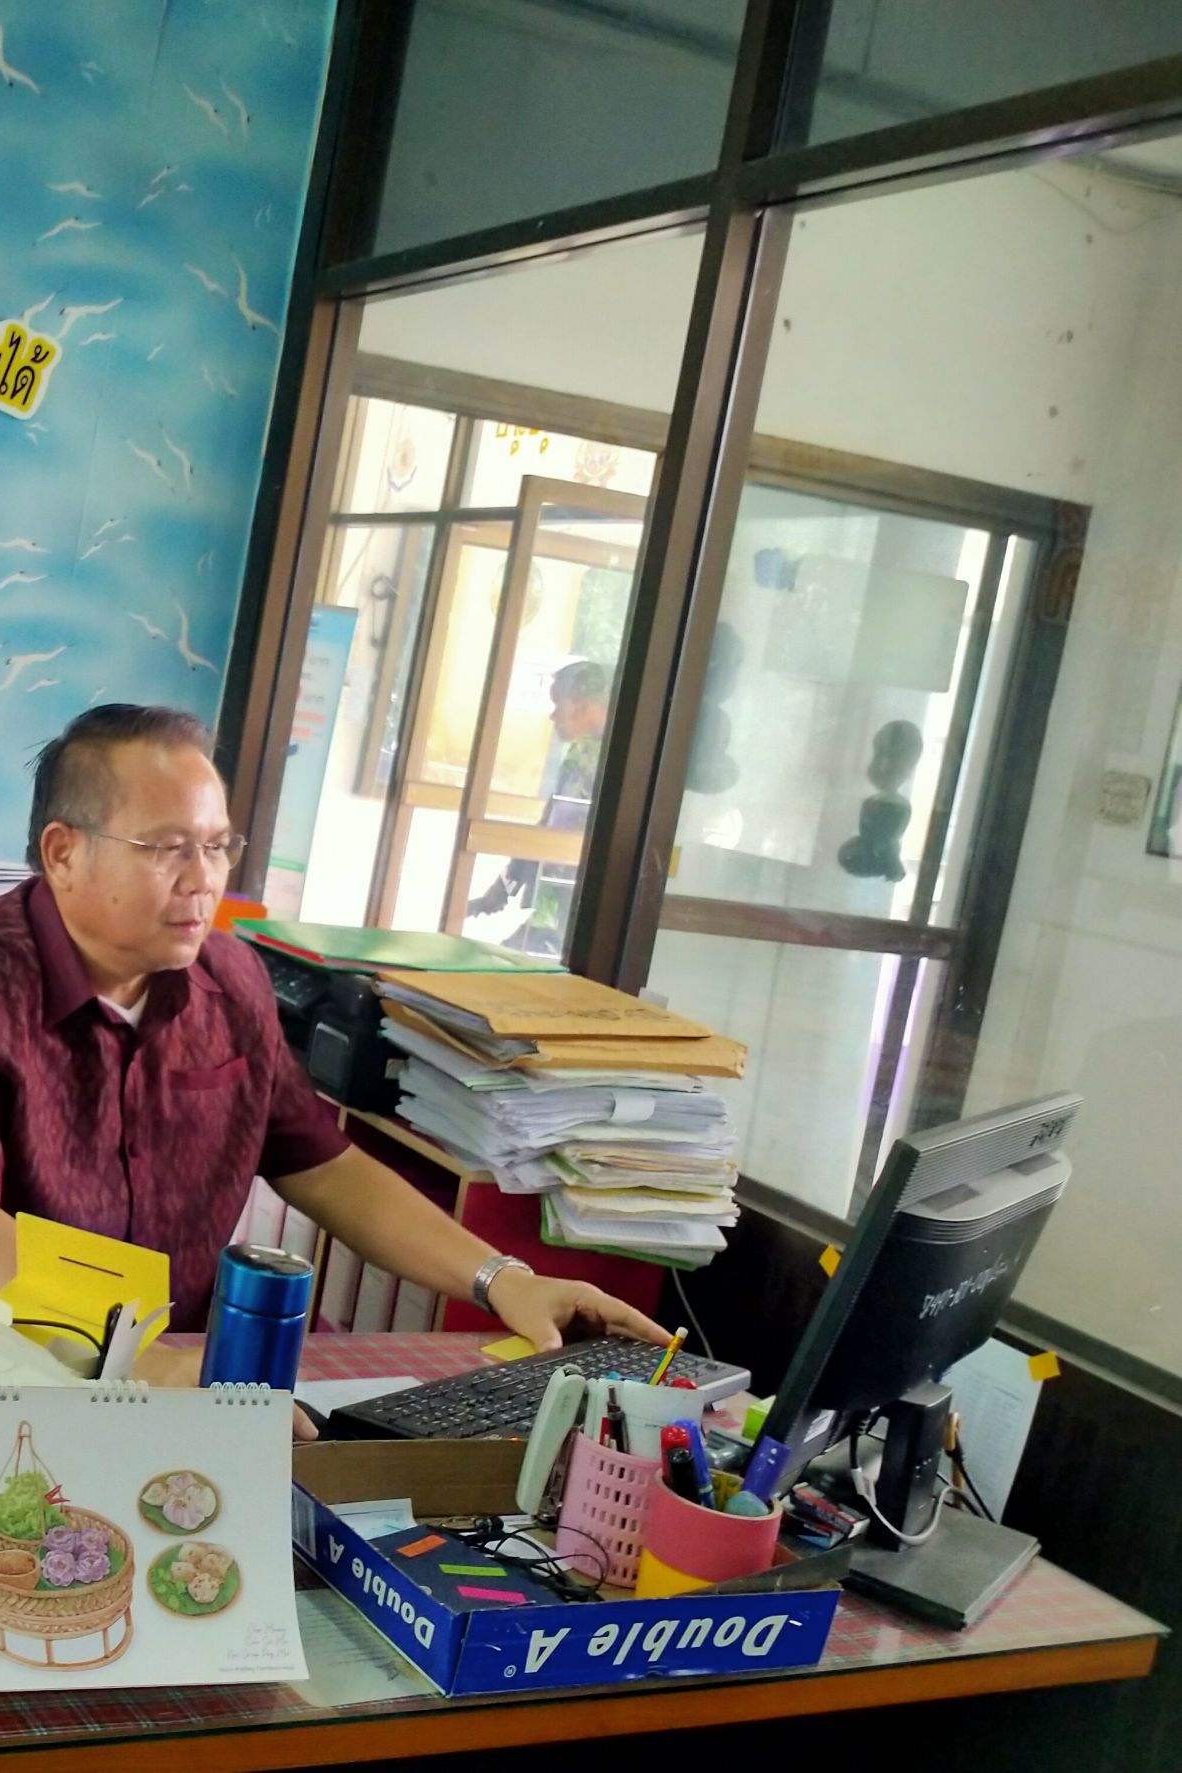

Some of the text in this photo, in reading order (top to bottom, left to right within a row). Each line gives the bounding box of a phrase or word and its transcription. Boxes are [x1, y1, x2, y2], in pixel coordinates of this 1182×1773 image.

[328, 1533, 436, 1650] Double A
[586, 1613, 790, 1666] Double
